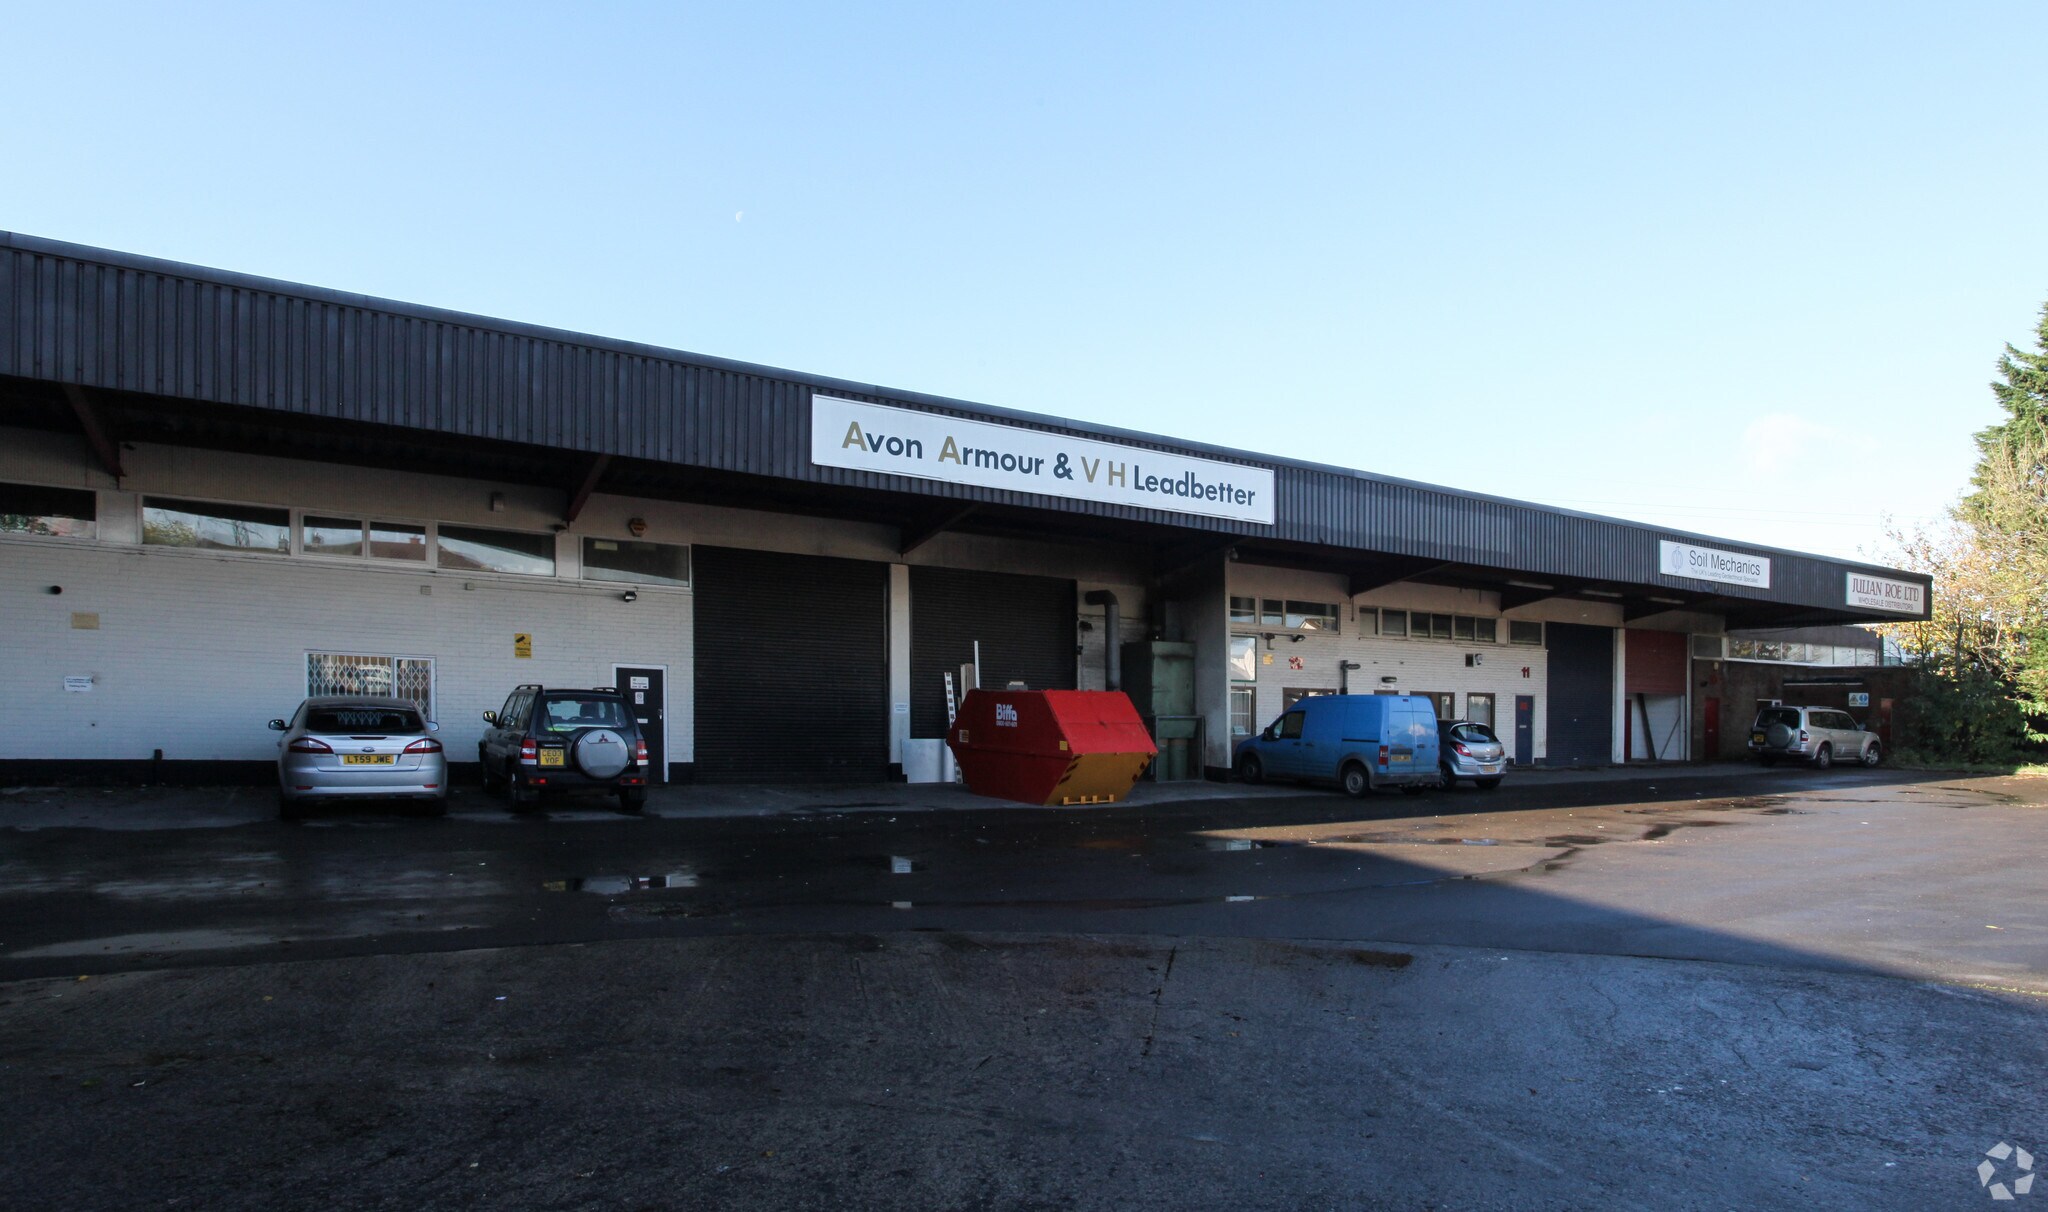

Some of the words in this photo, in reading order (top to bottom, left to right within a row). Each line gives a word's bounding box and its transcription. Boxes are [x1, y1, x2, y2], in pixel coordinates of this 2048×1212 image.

[841, 421, 923, 459] Avon
[938, 435, 1045, 476] Armour
[1053, 452, 1074, 480] &
[1081, 456, 1100, 483] V
[1108, 461, 1125, 488] H
[1134, 465, 1256, 506] Leadbetter
[1689, 550, 1708, 568] Soil
[1711, 554, 1760, 576] Mechanics
[1852, 578, 1882, 596] JULIAN
[1885, 583, 1902, 600] ROE
[1904, 586, 1919, 601] LTD
[1858, 596, 1884, 607] WHOLESALE
[1885, 600, 1914, 611] DISTRIBUTORS
[1521, 666, 1530, 678] 11
[996, 703, 1018, 721] Biffa
[347, 755, 372, 764] LT59
